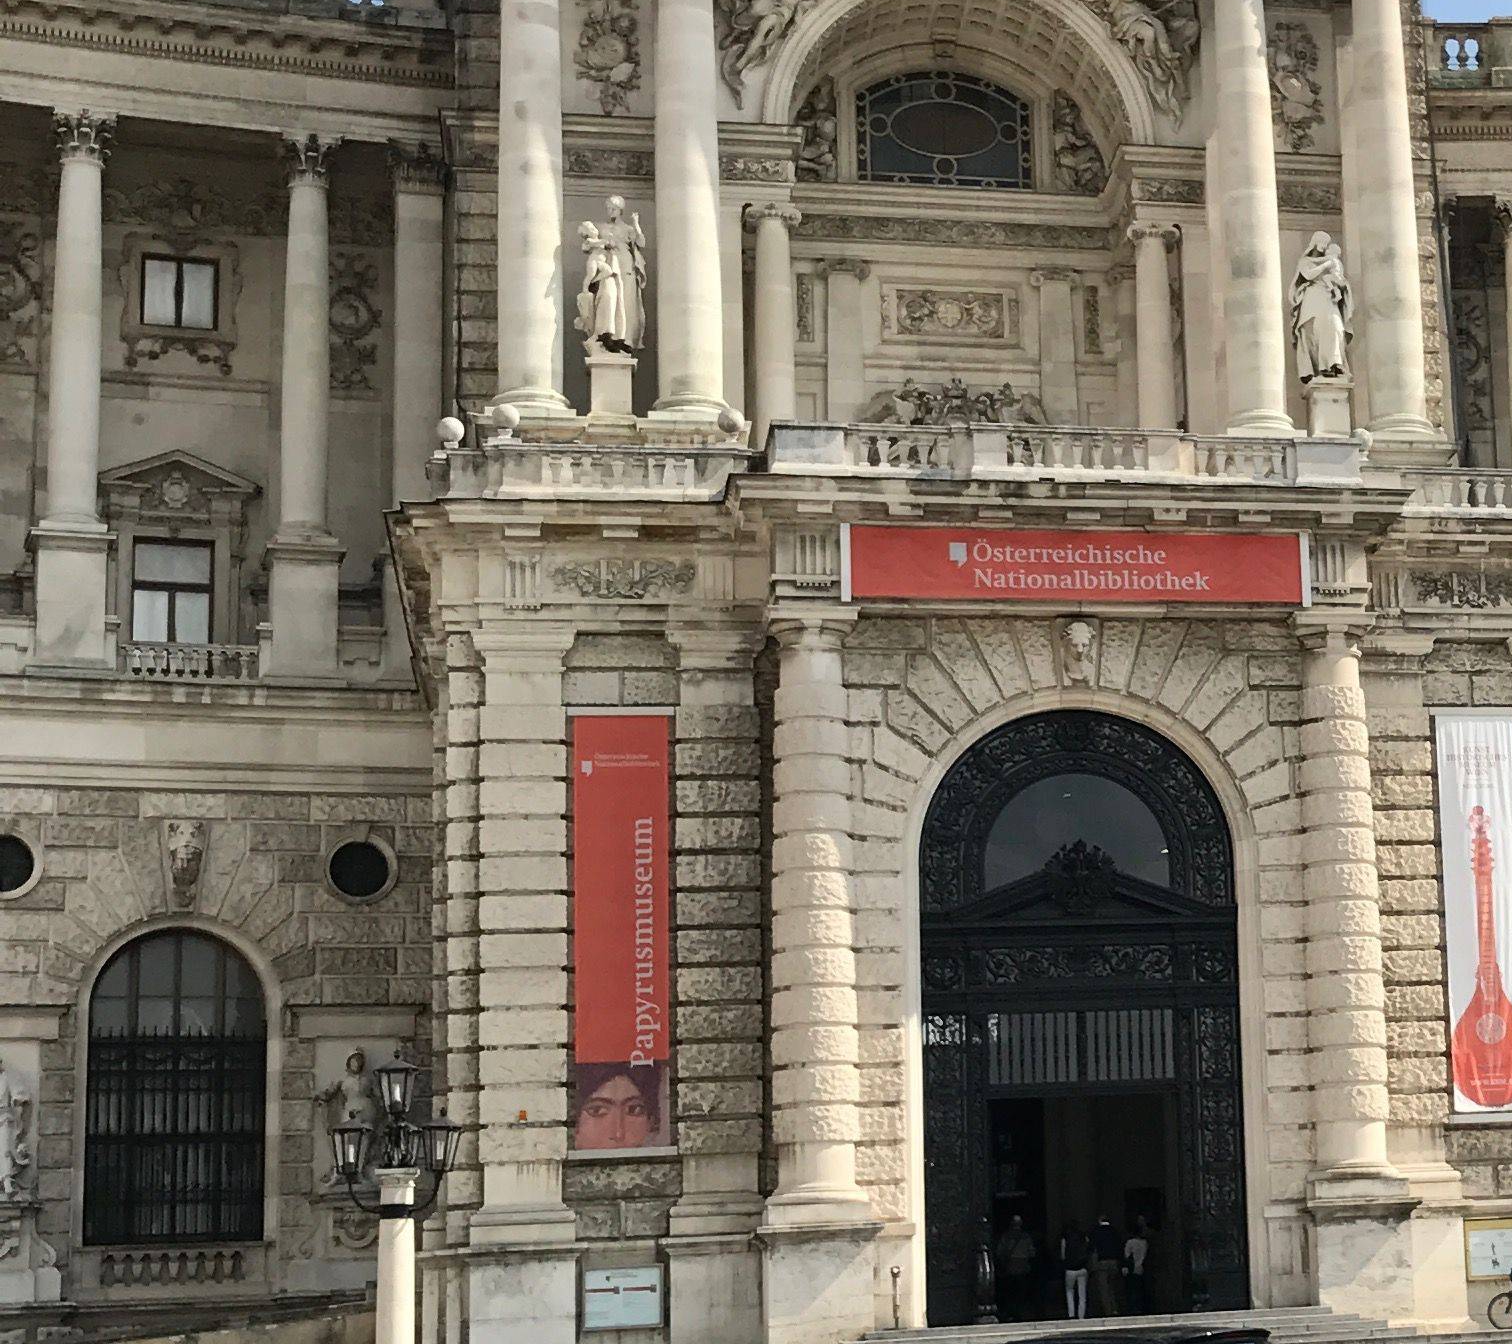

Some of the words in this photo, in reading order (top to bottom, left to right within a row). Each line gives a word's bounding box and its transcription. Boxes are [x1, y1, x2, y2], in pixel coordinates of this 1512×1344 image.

[973, 538, 1167, 565] Österreichische
[973, 568, 1210, 591] Nationalbibliothek
[630, 816, 661, 1068] Papyrusmuseum
